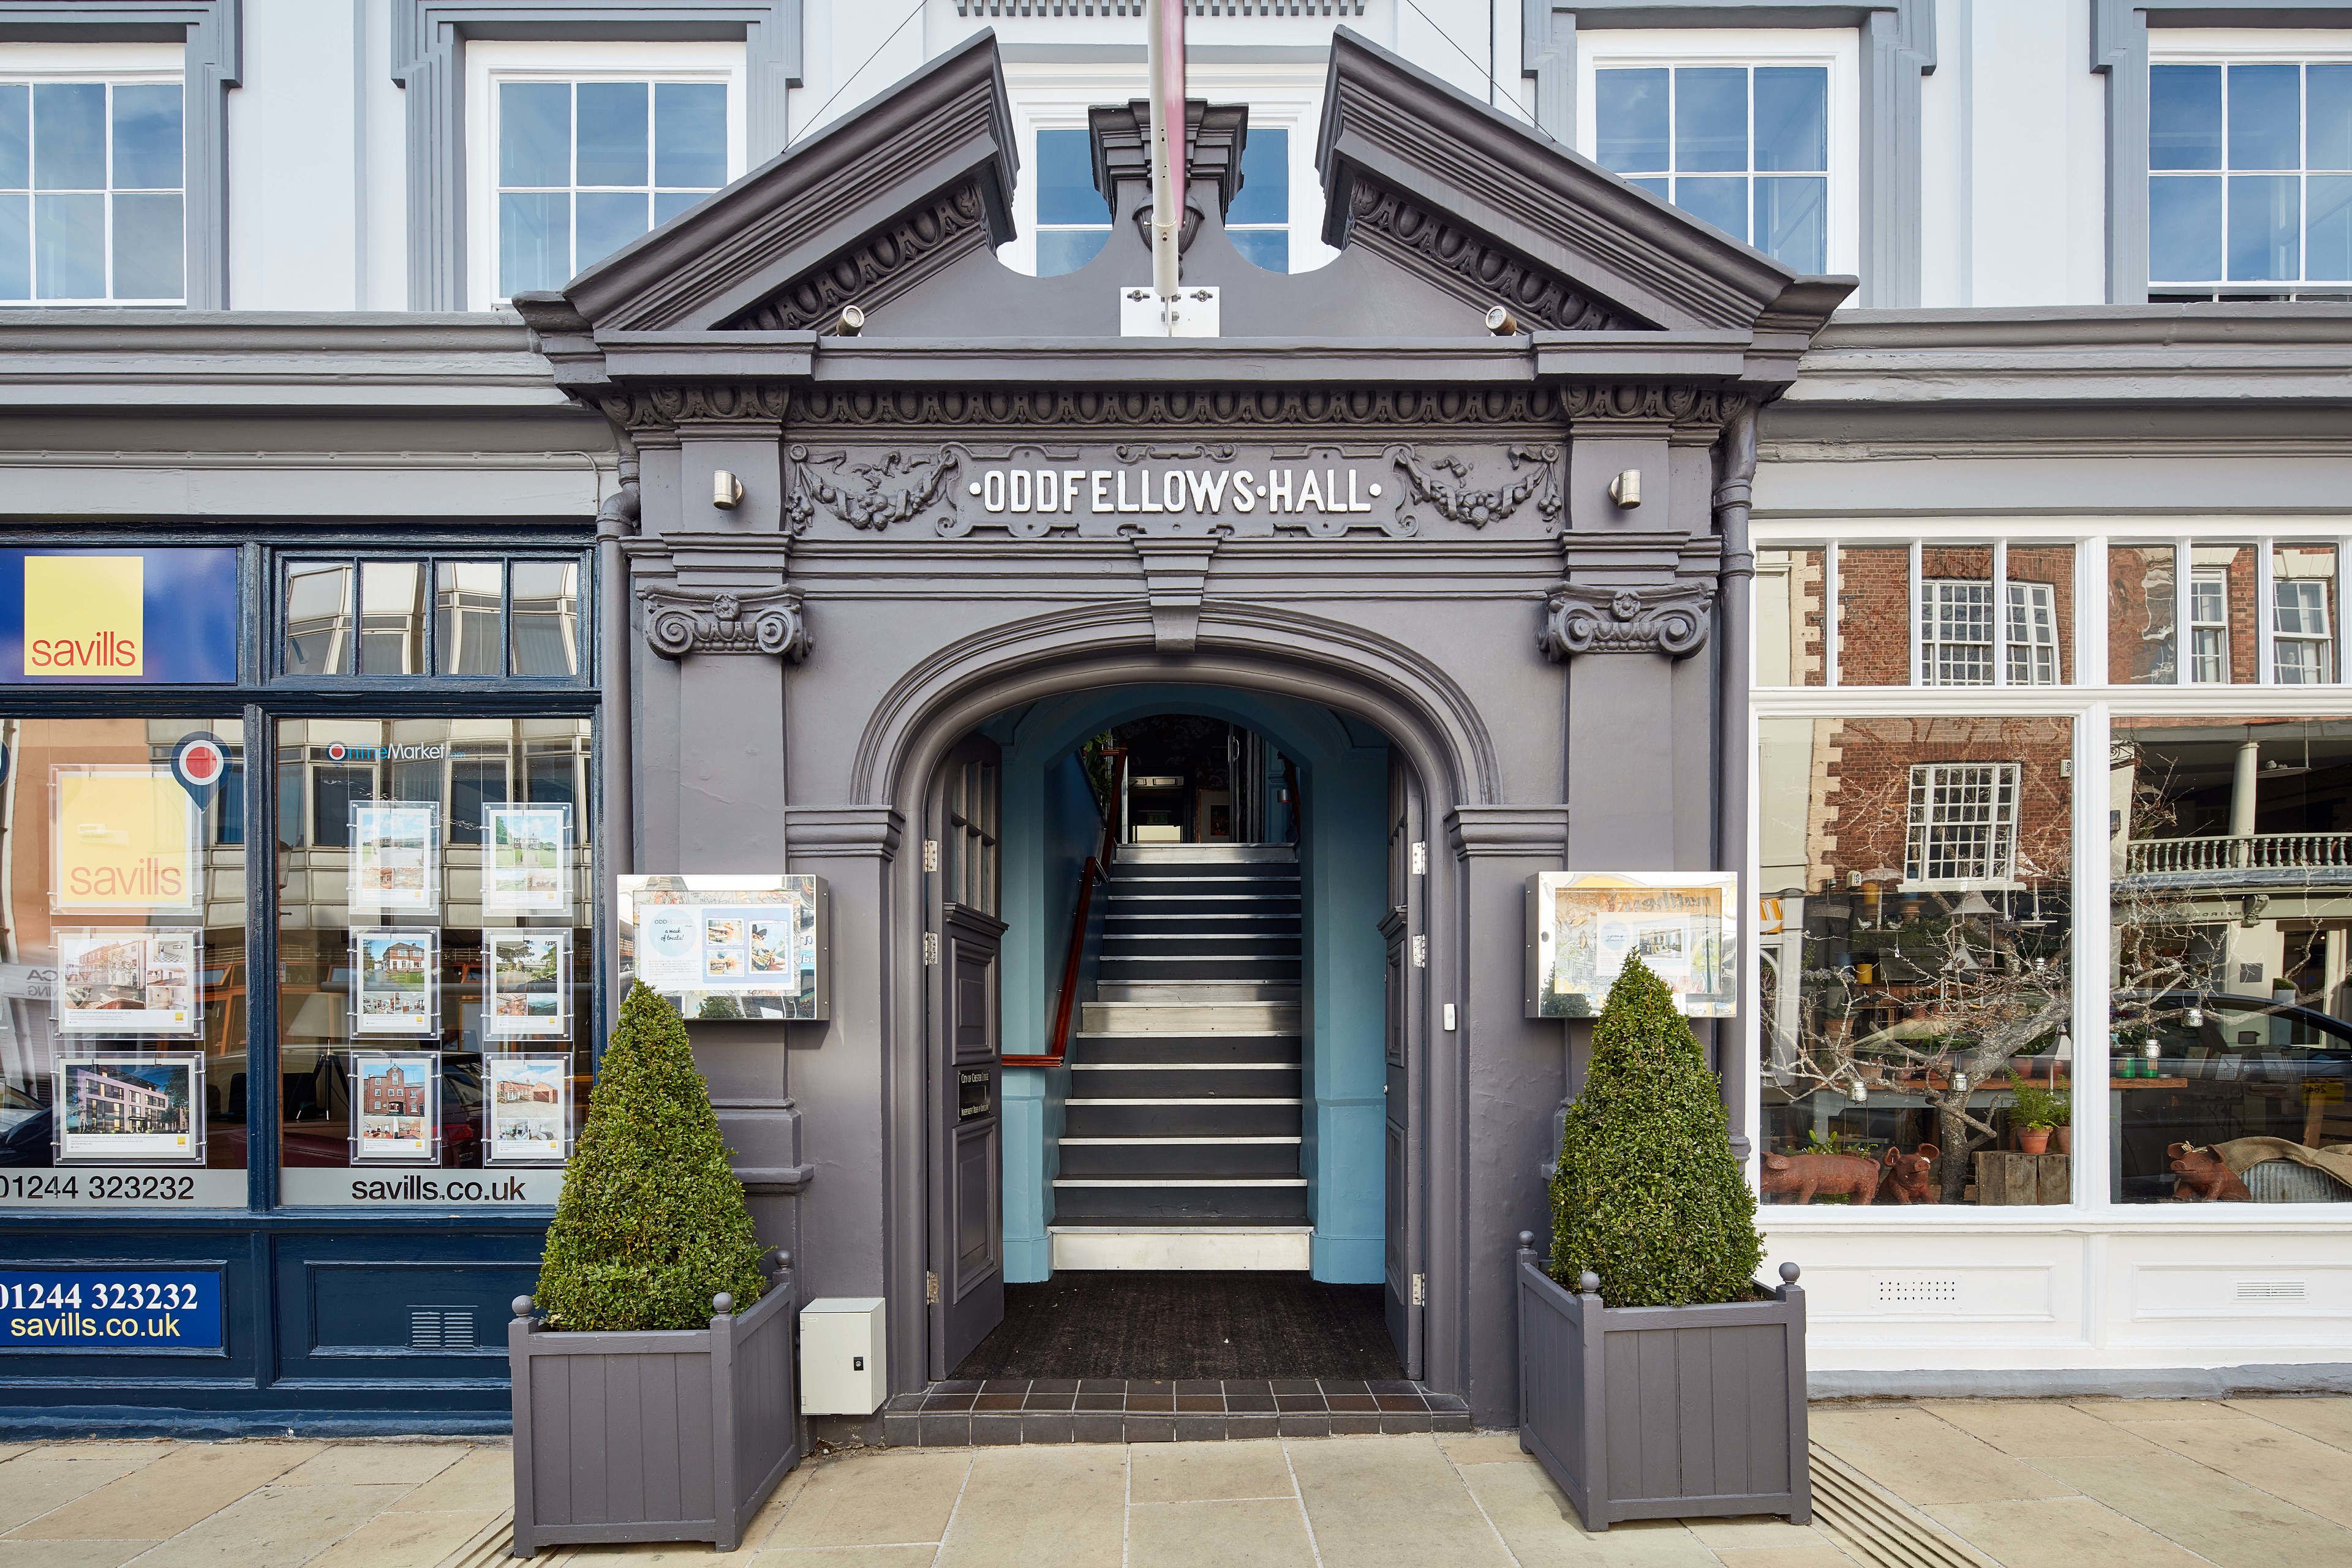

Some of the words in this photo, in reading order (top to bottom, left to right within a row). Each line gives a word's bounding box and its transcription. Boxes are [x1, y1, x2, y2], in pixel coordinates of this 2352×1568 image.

[31, 631, 136, 666] savills
[70, 858, 182, 895] savills
[88, 1175, 195, 1200] 323232
[352, 1175, 526, 1201] savills.co.uk
[91, 1283, 198, 1310] 323232
[10, 1312, 181, 1337] savills.co.uk
